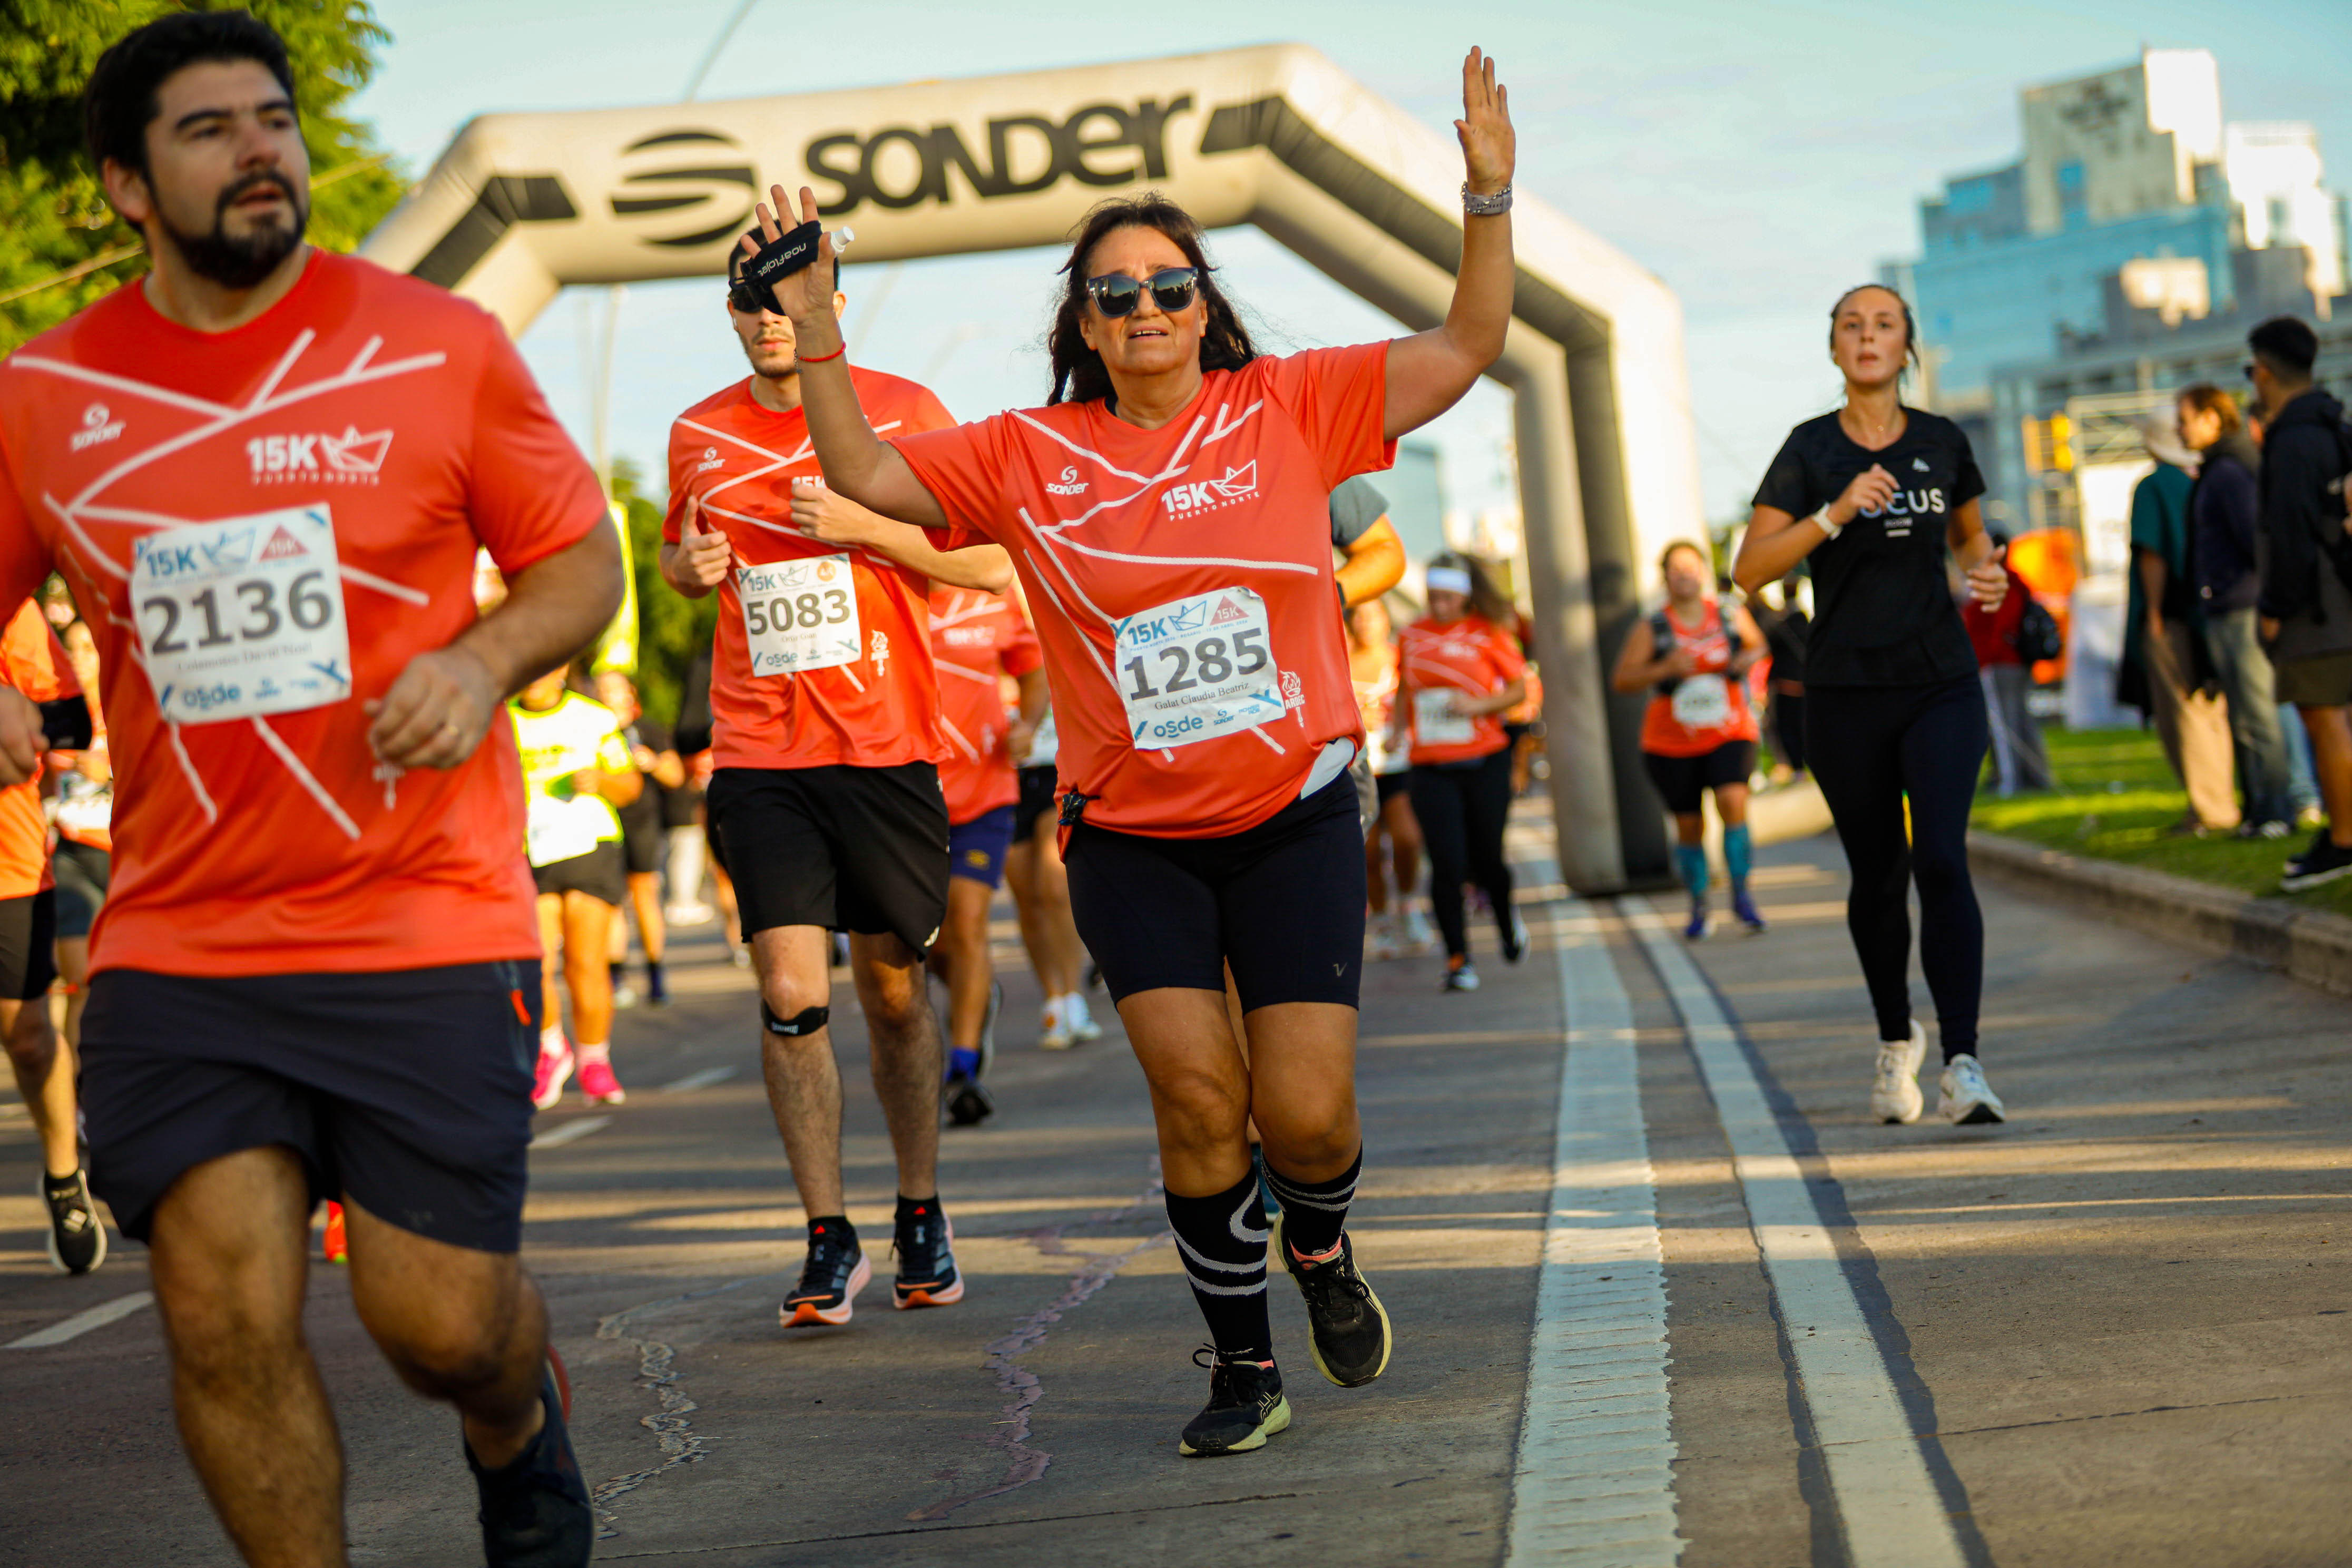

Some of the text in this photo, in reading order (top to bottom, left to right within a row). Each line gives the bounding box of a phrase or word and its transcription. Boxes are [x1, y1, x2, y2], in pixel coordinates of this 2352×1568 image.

[247, 434, 319, 472] 15K
[1161, 482, 1216, 513] 15K
[1170, 492, 1260, 521] PUERTO NORTE
[146, 545, 197, 577] 15K
[749, 574, 777, 591] 15K
[143, 571, 334, 655] 2136
[747, 589, 850, 635] 5083
[1217, 606, 1240, 620] 15K
[1128, 618, 1168, 645] 15K
[767, 651, 798, 667] osde
[1124, 628, 1267, 700] 1285
[1154, 682, 1249, 711] Galat Claudia Beatriz
[1285, 694, 1305, 710] ARDEC
[1154, 716, 1203, 738] osde
